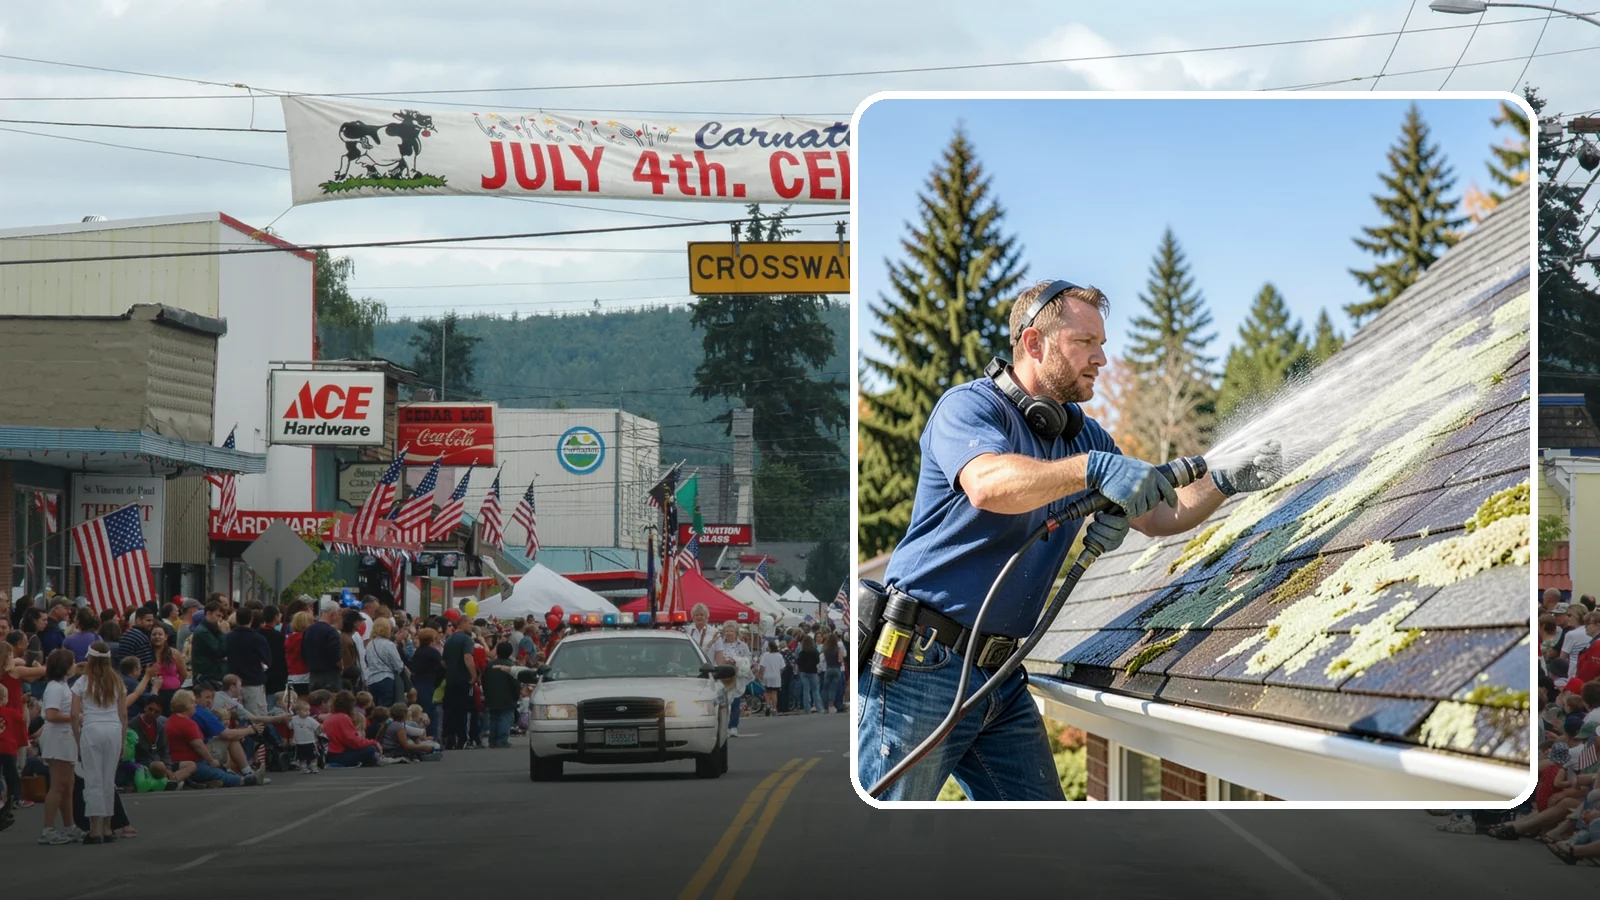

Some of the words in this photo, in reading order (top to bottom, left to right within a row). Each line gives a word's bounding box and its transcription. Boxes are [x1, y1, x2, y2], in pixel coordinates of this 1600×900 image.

[481, 141, 605, 192] JULY
[632, 150, 746, 197] 4th.
[697, 254, 850, 280] CROSSWA
[283, 380, 373, 420] ACE
[405, 409, 452, 422] CEDAR
[461, 409, 485, 421] LOG
[283, 421, 371, 436] Hardware
[416, 428, 477, 447] Coca-Cola
[96, 485, 124, 494] Vincent
[126, 486, 136, 494] de
[138, 486, 155, 495] Paul
[213, 516, 330, 535] HARDARE
[688, 526, 741, 535] CRNATION
[699, 535, 730, 543] GLASS
